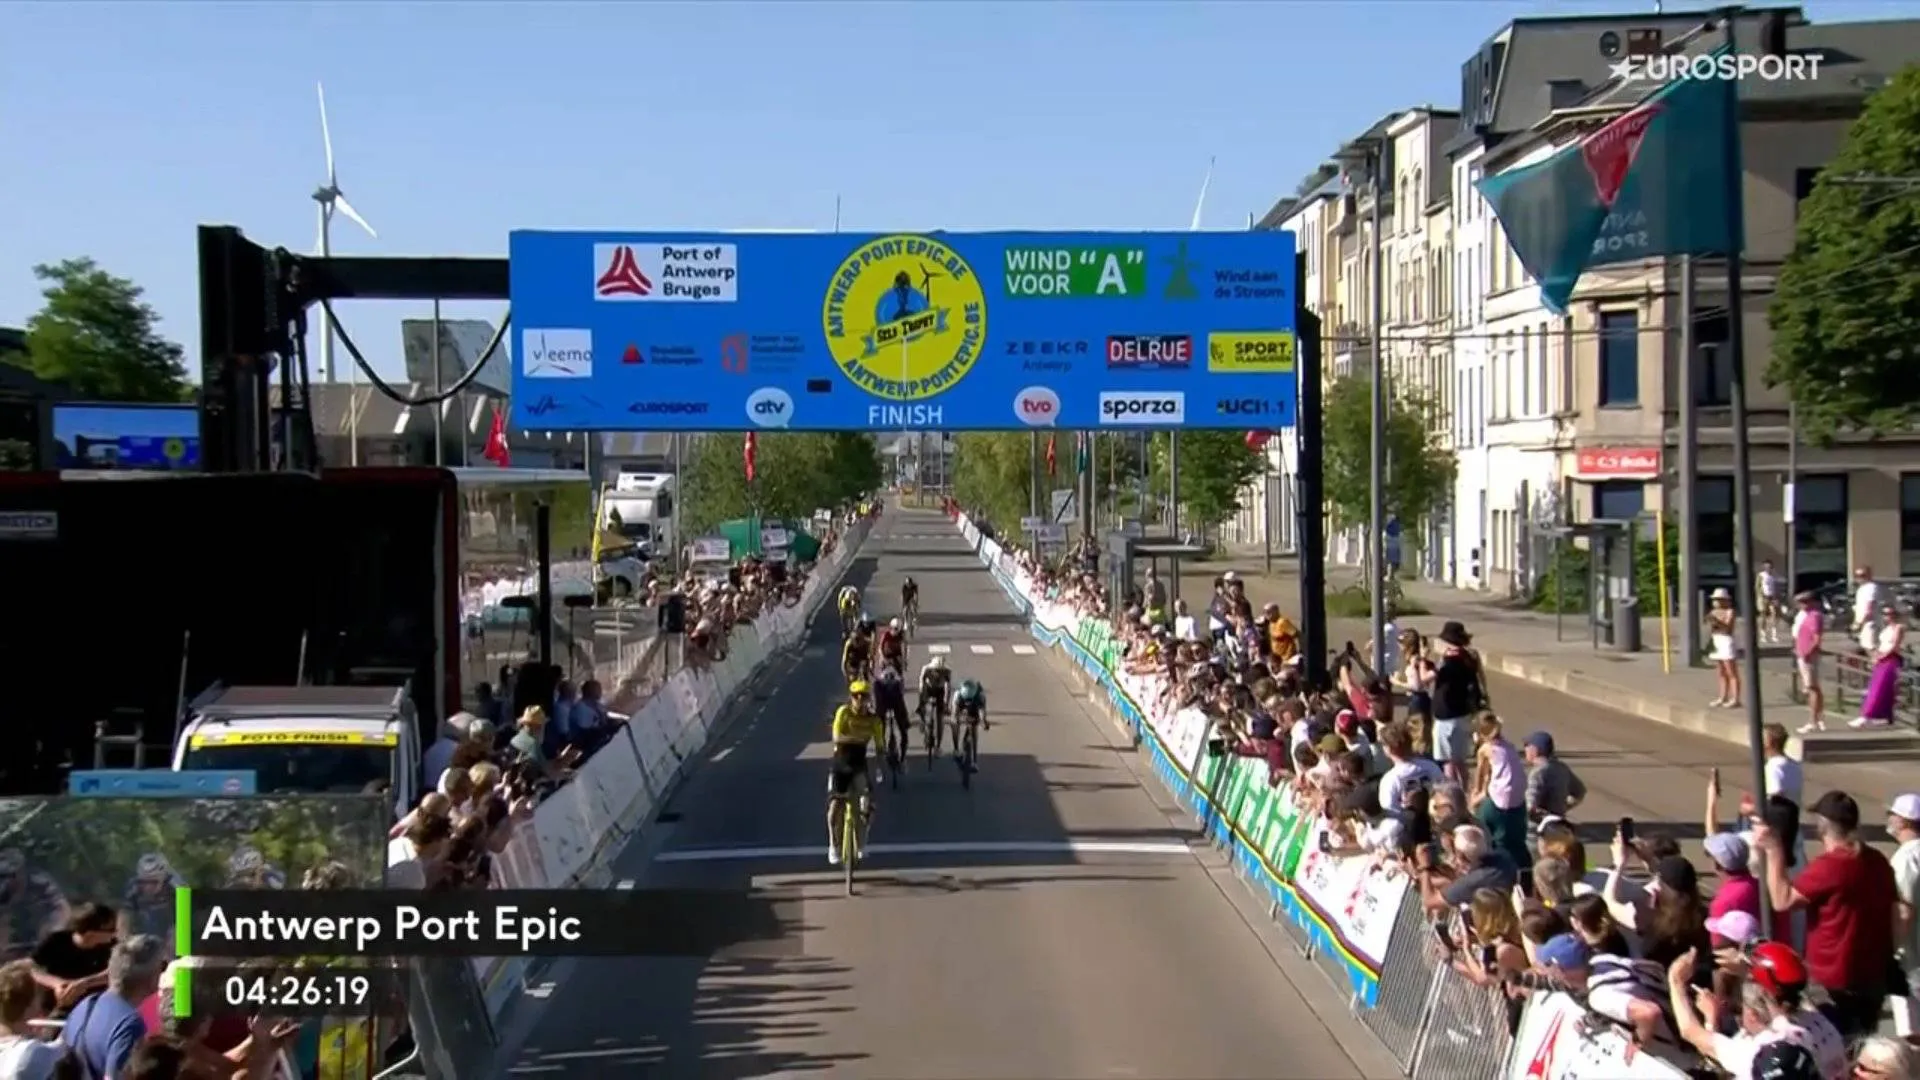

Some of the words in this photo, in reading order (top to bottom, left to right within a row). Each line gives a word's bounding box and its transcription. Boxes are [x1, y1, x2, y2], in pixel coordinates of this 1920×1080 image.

[662, 246, 698, 261] Port
[703, 246, 722, 261] of
[1005, 249, 1072, 271] WIND
[662, 264, 736, 283] Antwerp
[662, 281, 722, 299] Bruges
[1005, 273, 1072, 295] VOOR
[1110, 340, 1189, 361] DELRUE
[754, 400, 786, 415] atv
[1022, 398, 1053, 413] tvo
[868, 405, 943, 426] FINISH
